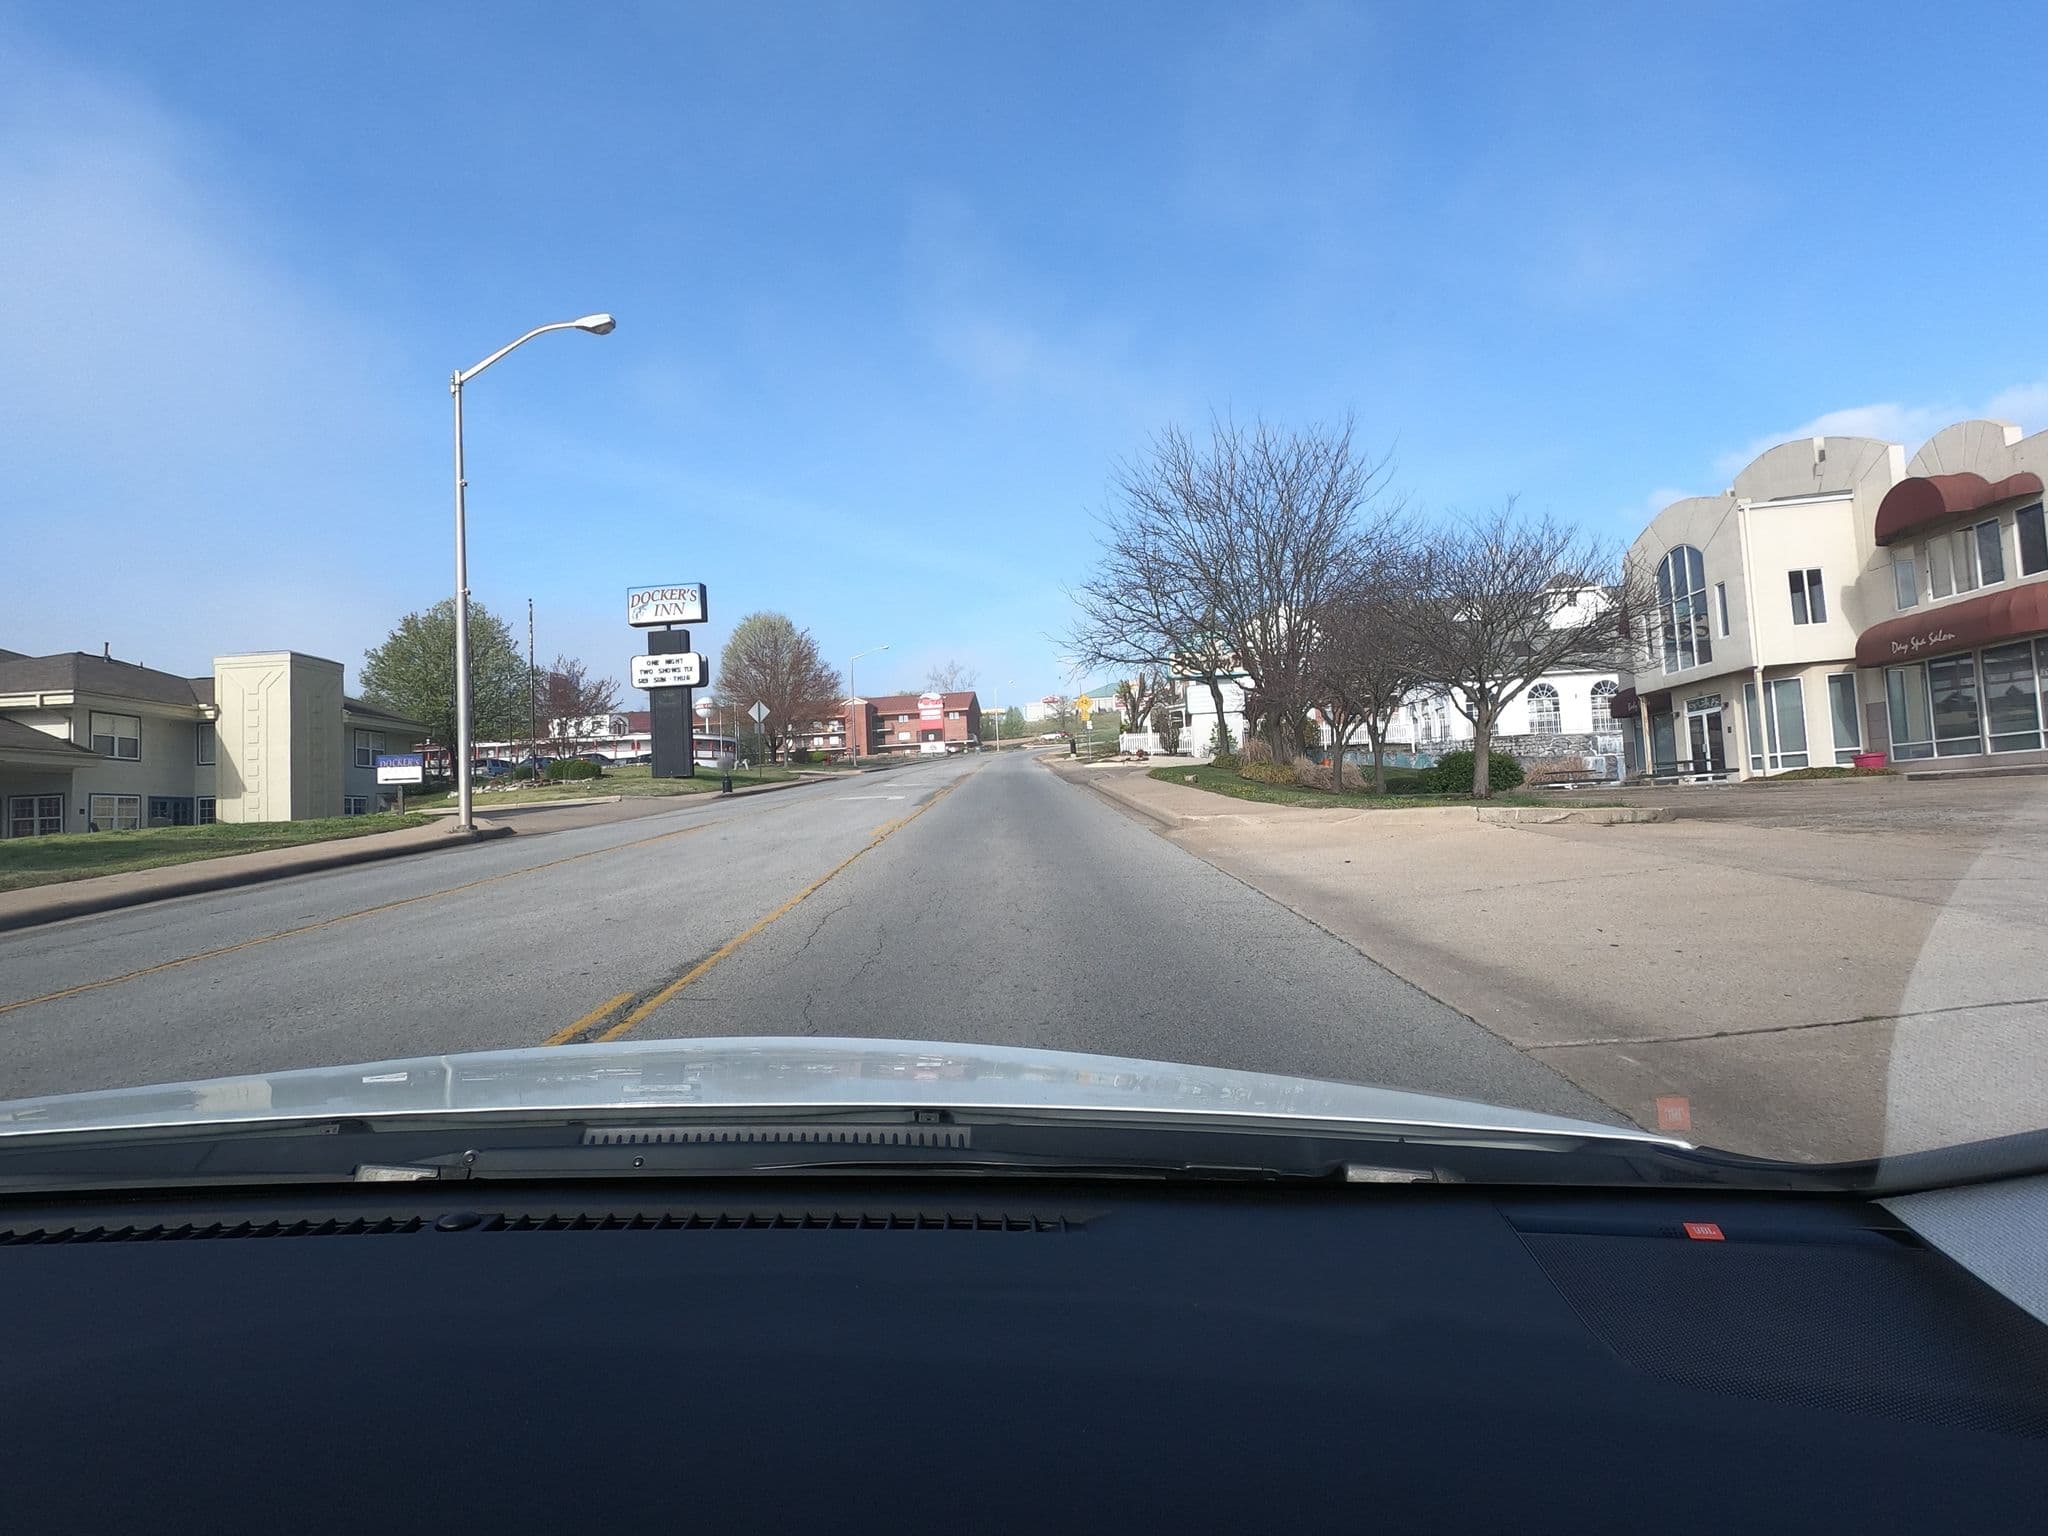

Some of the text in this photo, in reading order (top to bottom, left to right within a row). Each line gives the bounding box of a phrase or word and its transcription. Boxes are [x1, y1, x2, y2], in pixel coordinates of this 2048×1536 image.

[630, 588, 697, 608] DOCKER'S
[654, 602, 686, 616] INN
[1891, 629, 1955, 654] Day Spa Salon
